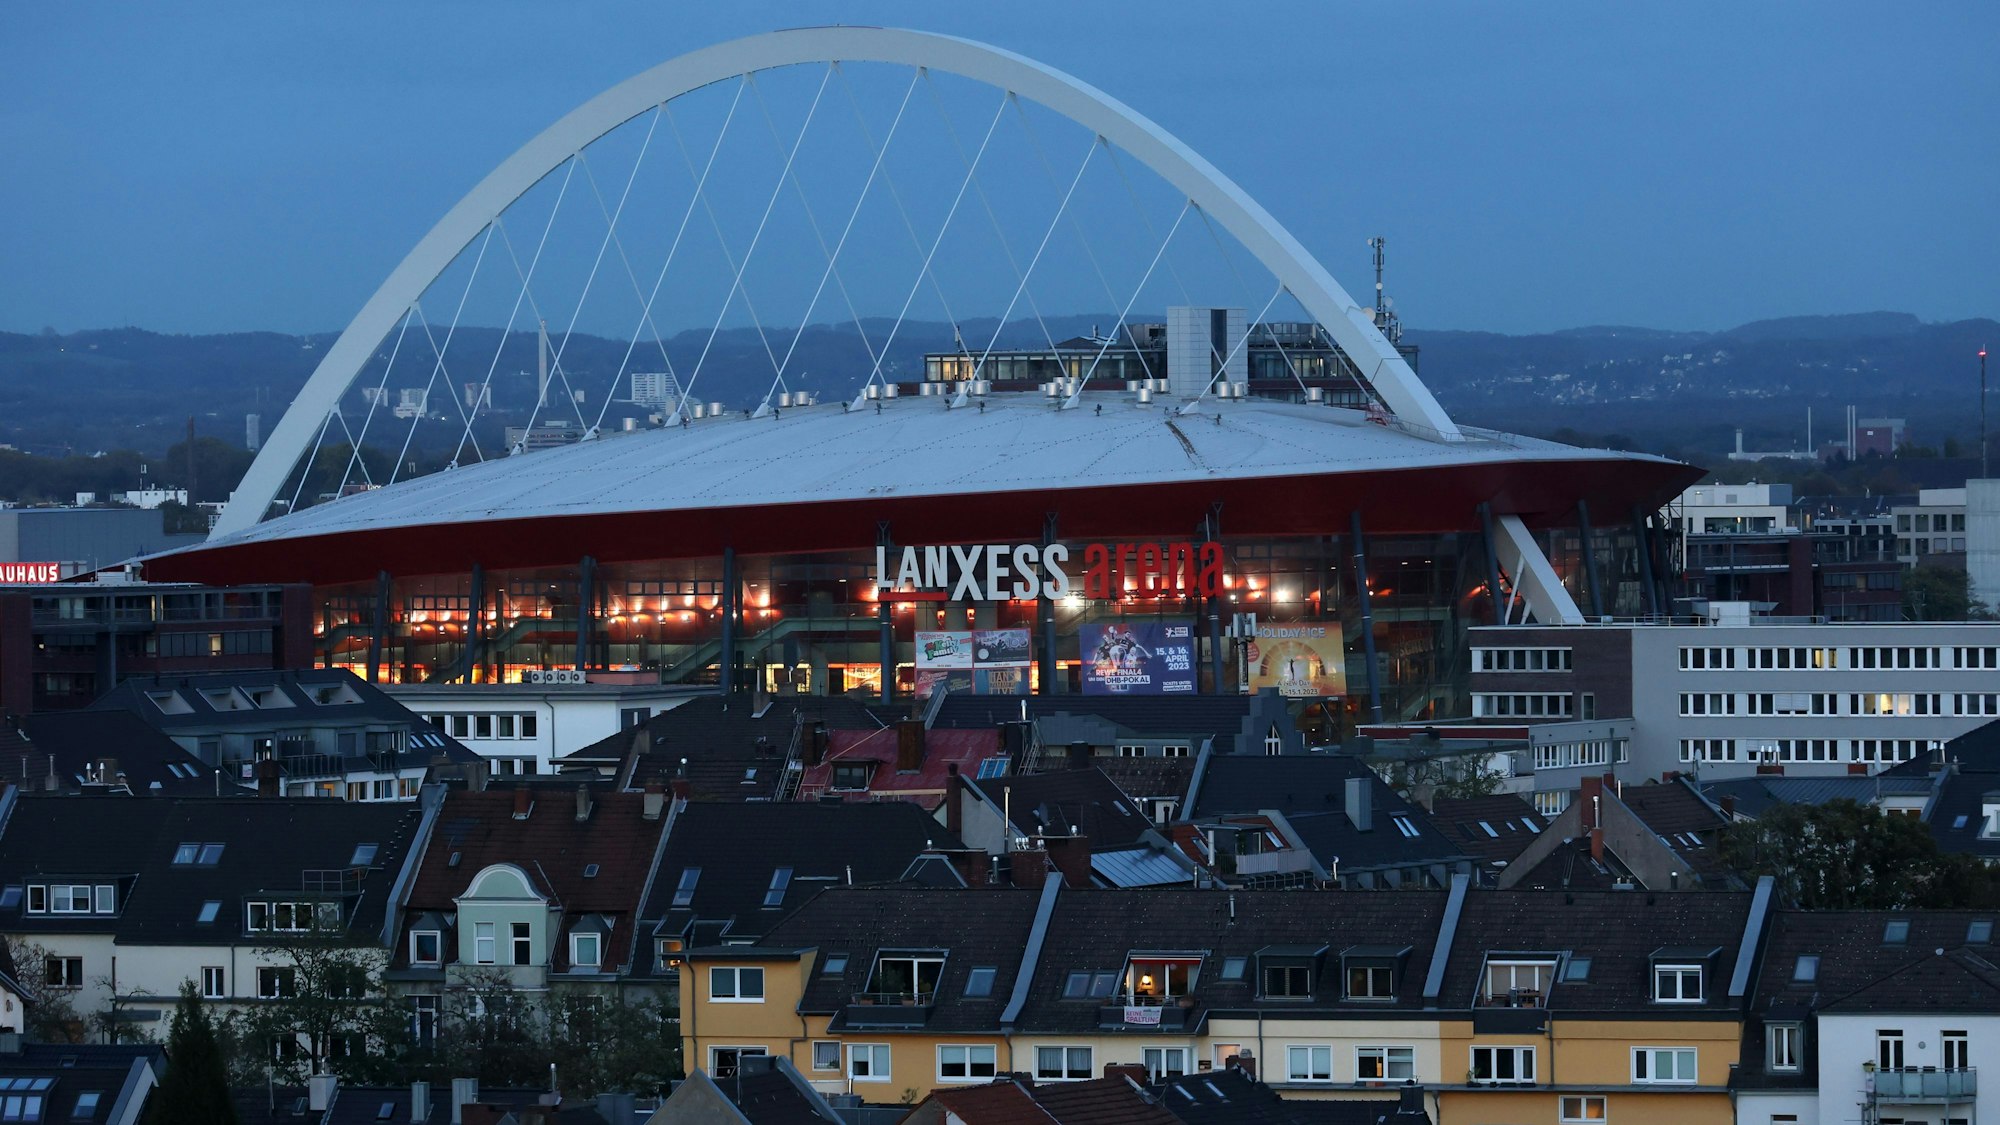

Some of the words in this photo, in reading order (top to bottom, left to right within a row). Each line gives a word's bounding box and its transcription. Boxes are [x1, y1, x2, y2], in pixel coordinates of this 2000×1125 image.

[876, 543, 1069, 601] LANXESS
[1083, 541, 1224, 601] arena
[1255, 627, 1300, 638] HOLIDAY
[1307, 627, 1326, 638] ICE
[1155, 647, 1167, 656] 15.
[1168, 647, 1176, 655] &
[1177, 646, 1189, 655] 16.
[1165, 655, 1190, 663] APRIL
[1168, 662, 1190, 671] 2023
[1095, 668, 1116, 676] REWE
[1117, 668, 1143, 676] FINAL4
[1106, 676, 1149, 684] DHB-POKAL
